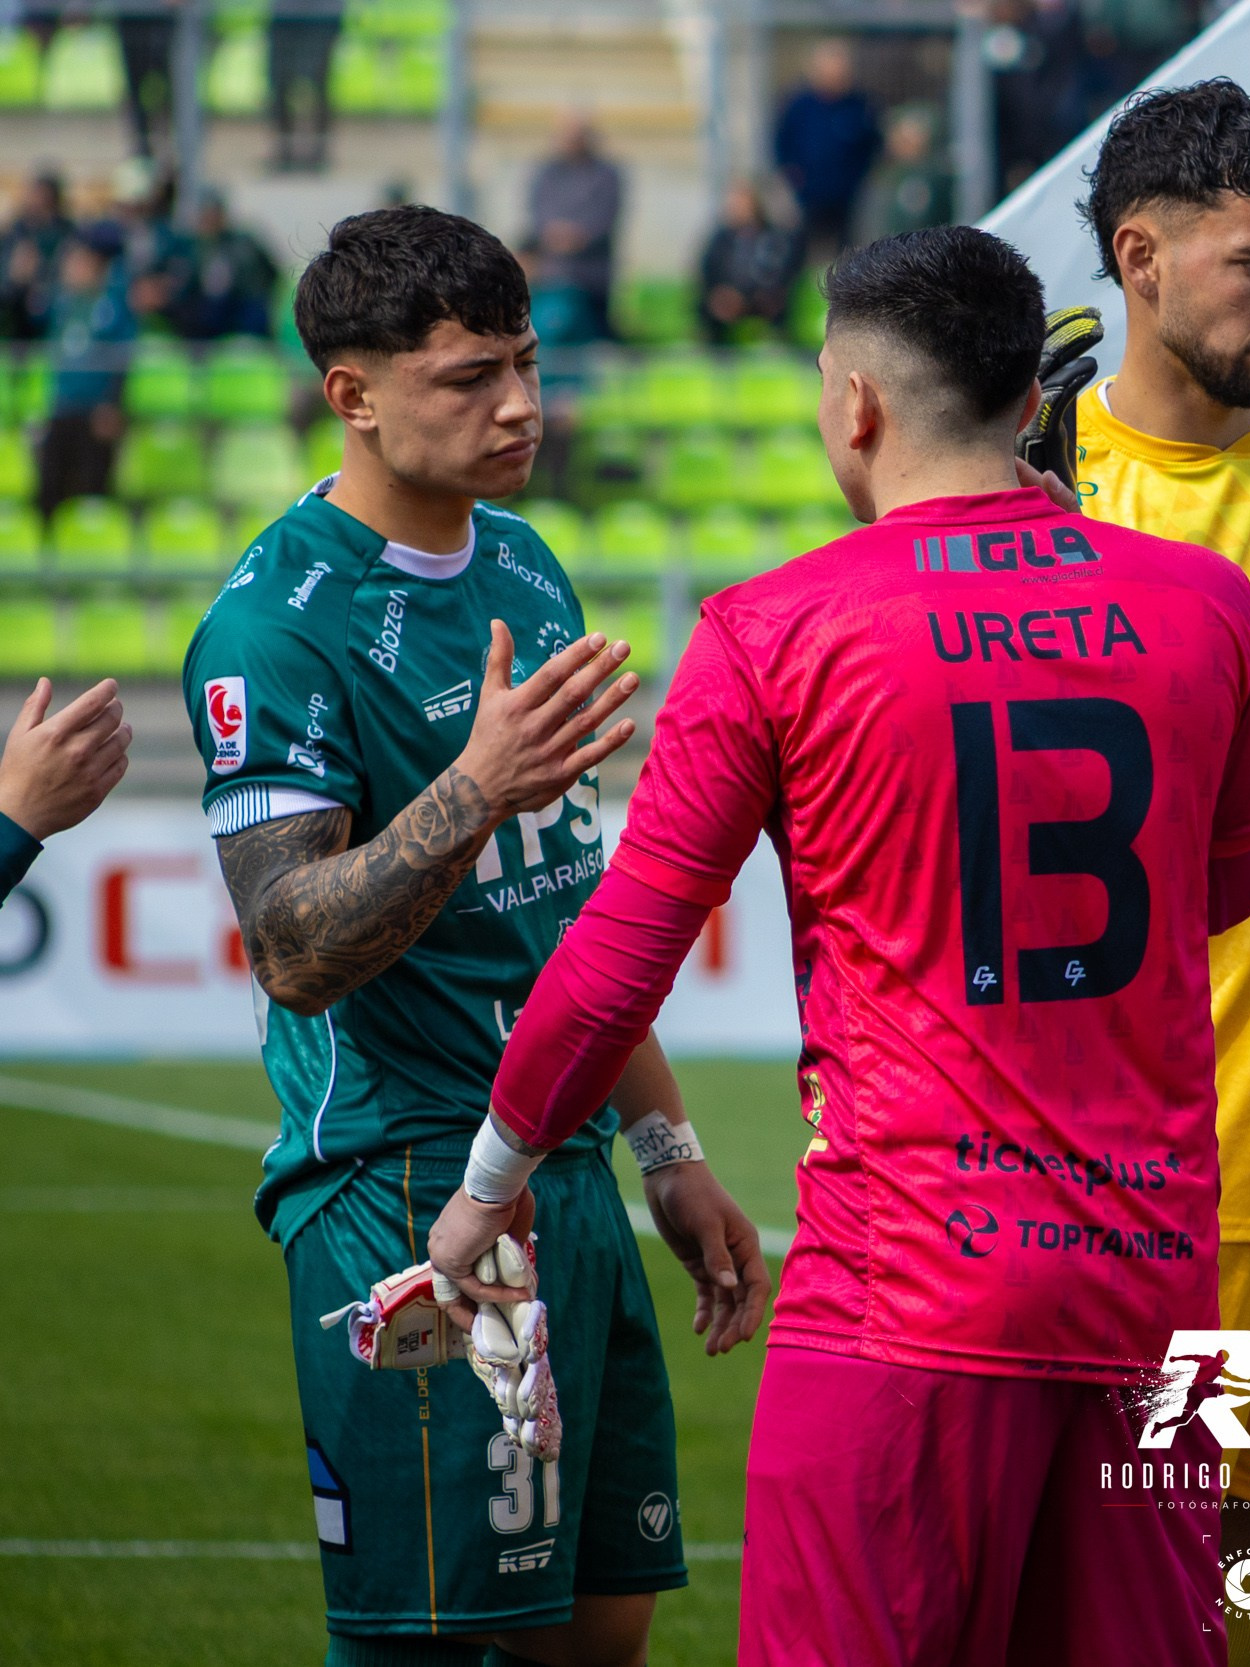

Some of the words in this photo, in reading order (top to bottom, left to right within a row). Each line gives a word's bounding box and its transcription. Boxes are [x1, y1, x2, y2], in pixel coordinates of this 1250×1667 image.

[976, 527, 1101, 571] GLA
[368, 589, 409, 674] Biozen
[927, 602, 1148, 663] URETA
[950, 697, 1155, 1006] 13
[1017, 1219, 1194, 1260] TOPTAINER
[486, 1430, 561, 1535] 31
